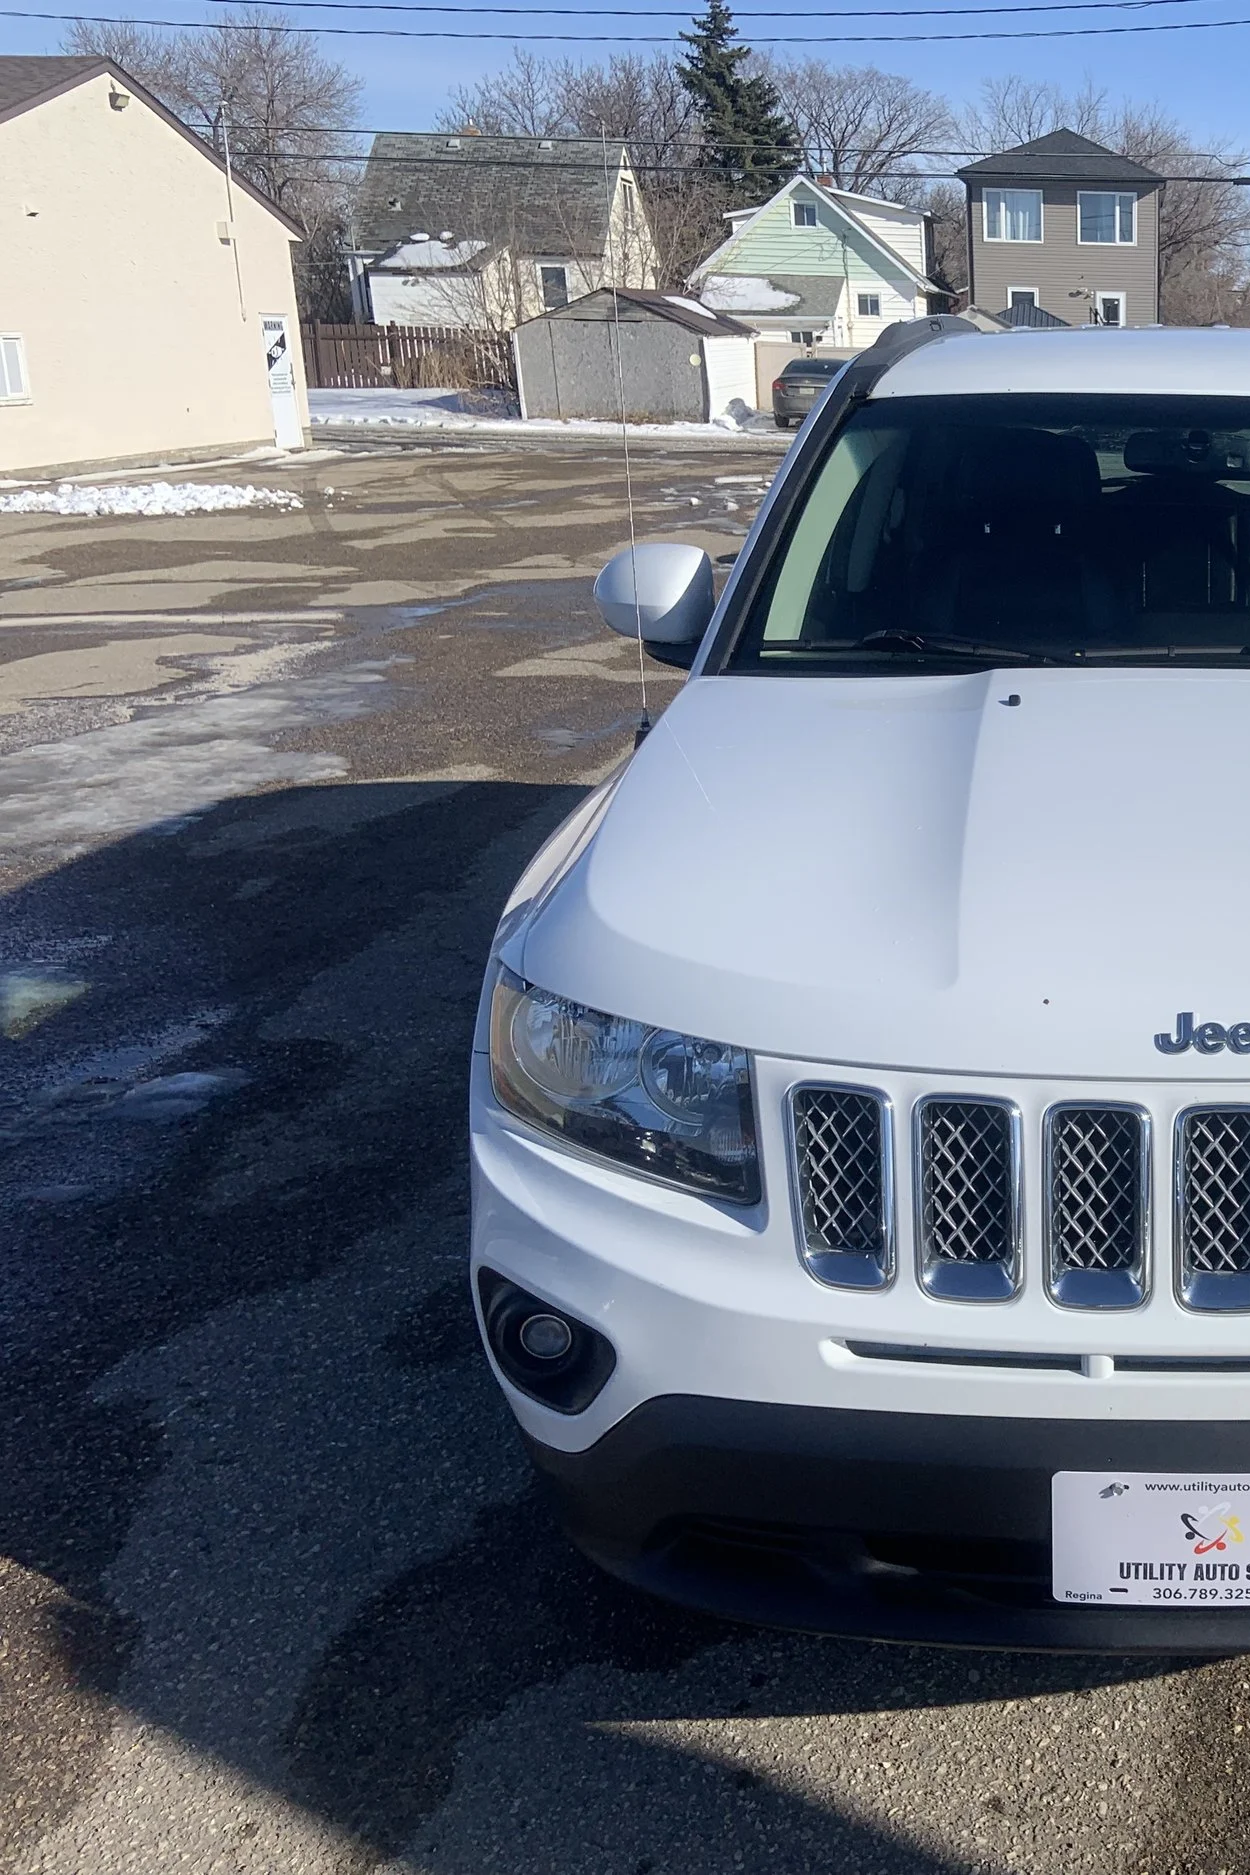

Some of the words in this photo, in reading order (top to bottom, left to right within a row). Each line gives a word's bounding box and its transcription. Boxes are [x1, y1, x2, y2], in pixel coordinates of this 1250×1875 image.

[263, 321, 284, 331] WARNING
[1119, 1562, 1187, 1581] UTILITY
[1193, 1563, 1240, 1581] AUTO
[1064, 1590, 1103, 1601] Regina
